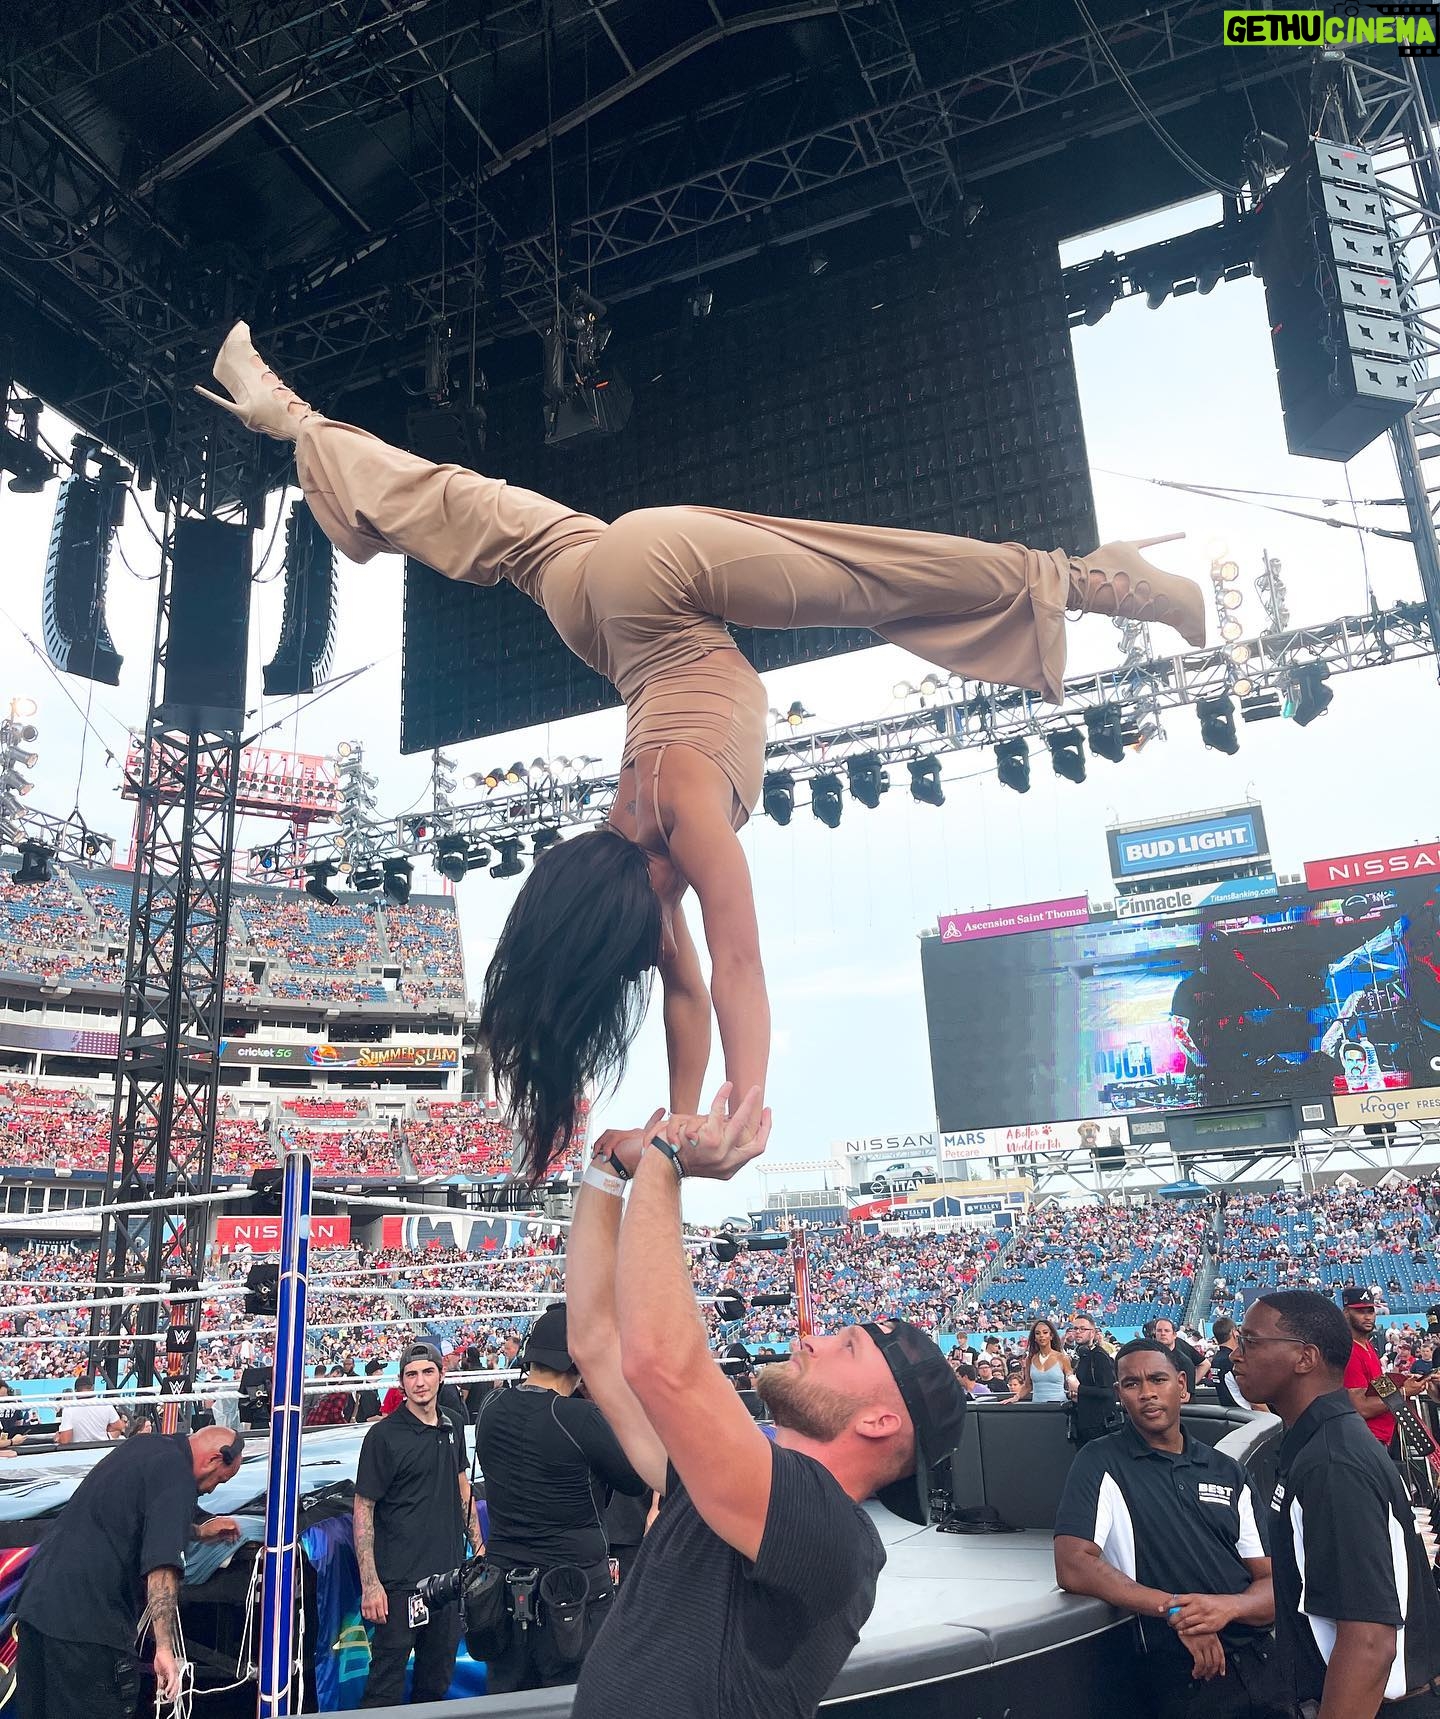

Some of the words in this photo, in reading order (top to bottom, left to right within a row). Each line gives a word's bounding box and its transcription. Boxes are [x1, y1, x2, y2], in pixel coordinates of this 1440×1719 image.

[1126, 839, 1175, 862] BUD
[1328, 851, 1440, 881] NISSA
[1210, 886, 1276, 903] TitansBanking.com
[1119, 892, 1192, 915] Pinnacle
[964, 917, 1015, 932] Ascension
[1017, 913, 1044, 924] Saint
[1045, 907, 1088, 920] Thomas
[1263, 925, 1294, 934] NISSAN
[238, 1047, 274, 1058] cricket
[275, 1049, 292, 1058] 5G
[1360, 1095, 1410, 1119] Kroger
[944, 1132, 985, 1147] MARS
[1006, 1129, 1014, 1139] A
[1015, 1126, 1040, 1139] Better
[846, 1134, 933, 1152] NISSAN
[1006, 1140, 1033, 1153] World
[945, 1150, 980, 1159] Petcare
[971, 1203, 1000, 1211] WESLEY
[1198, 1483, 1233, 1496] BEST
